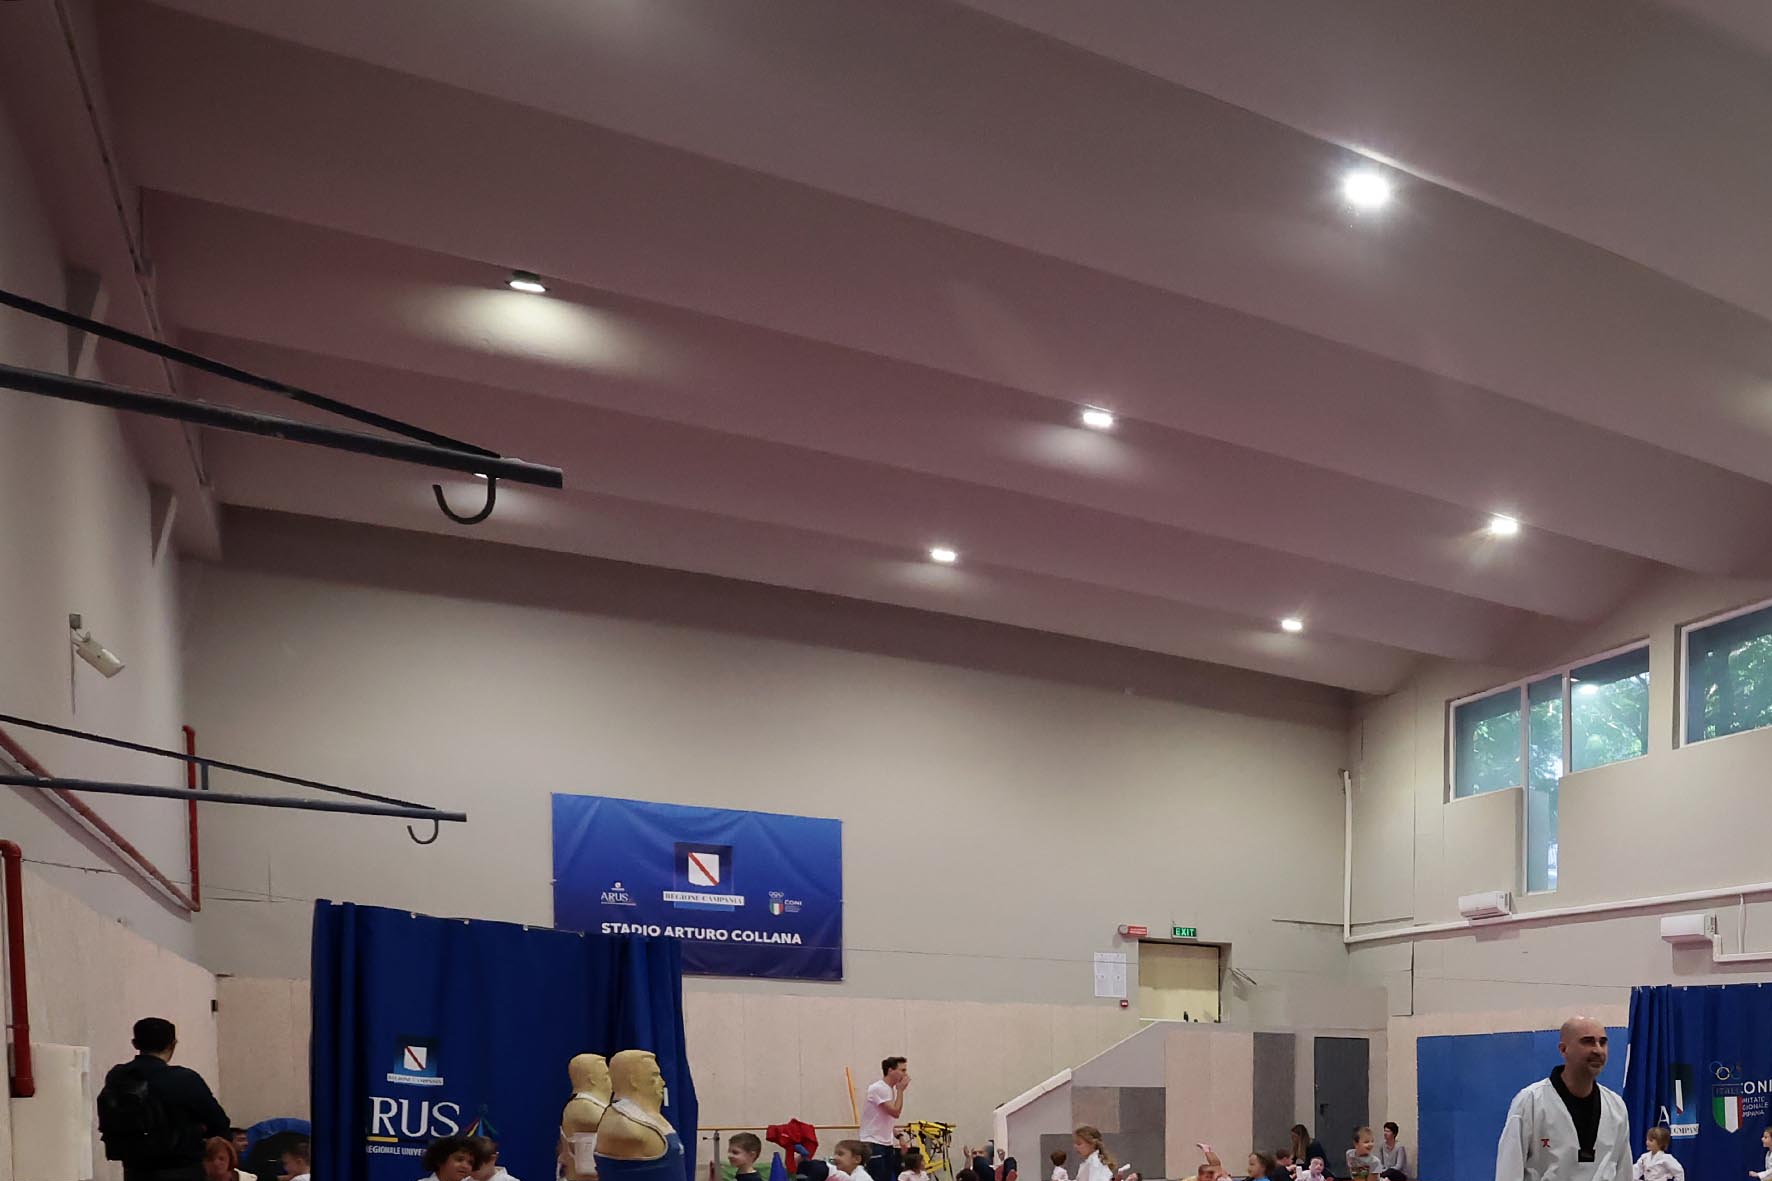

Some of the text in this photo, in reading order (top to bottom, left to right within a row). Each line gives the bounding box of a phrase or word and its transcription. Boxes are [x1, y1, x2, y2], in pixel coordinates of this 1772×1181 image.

[664, 893, 743, 904] REGIONE CAMPANIA
[601, 922, 802, 945] STADIO ARTURO COLLANA
[1175, 928, 1195, 937] EXIT
